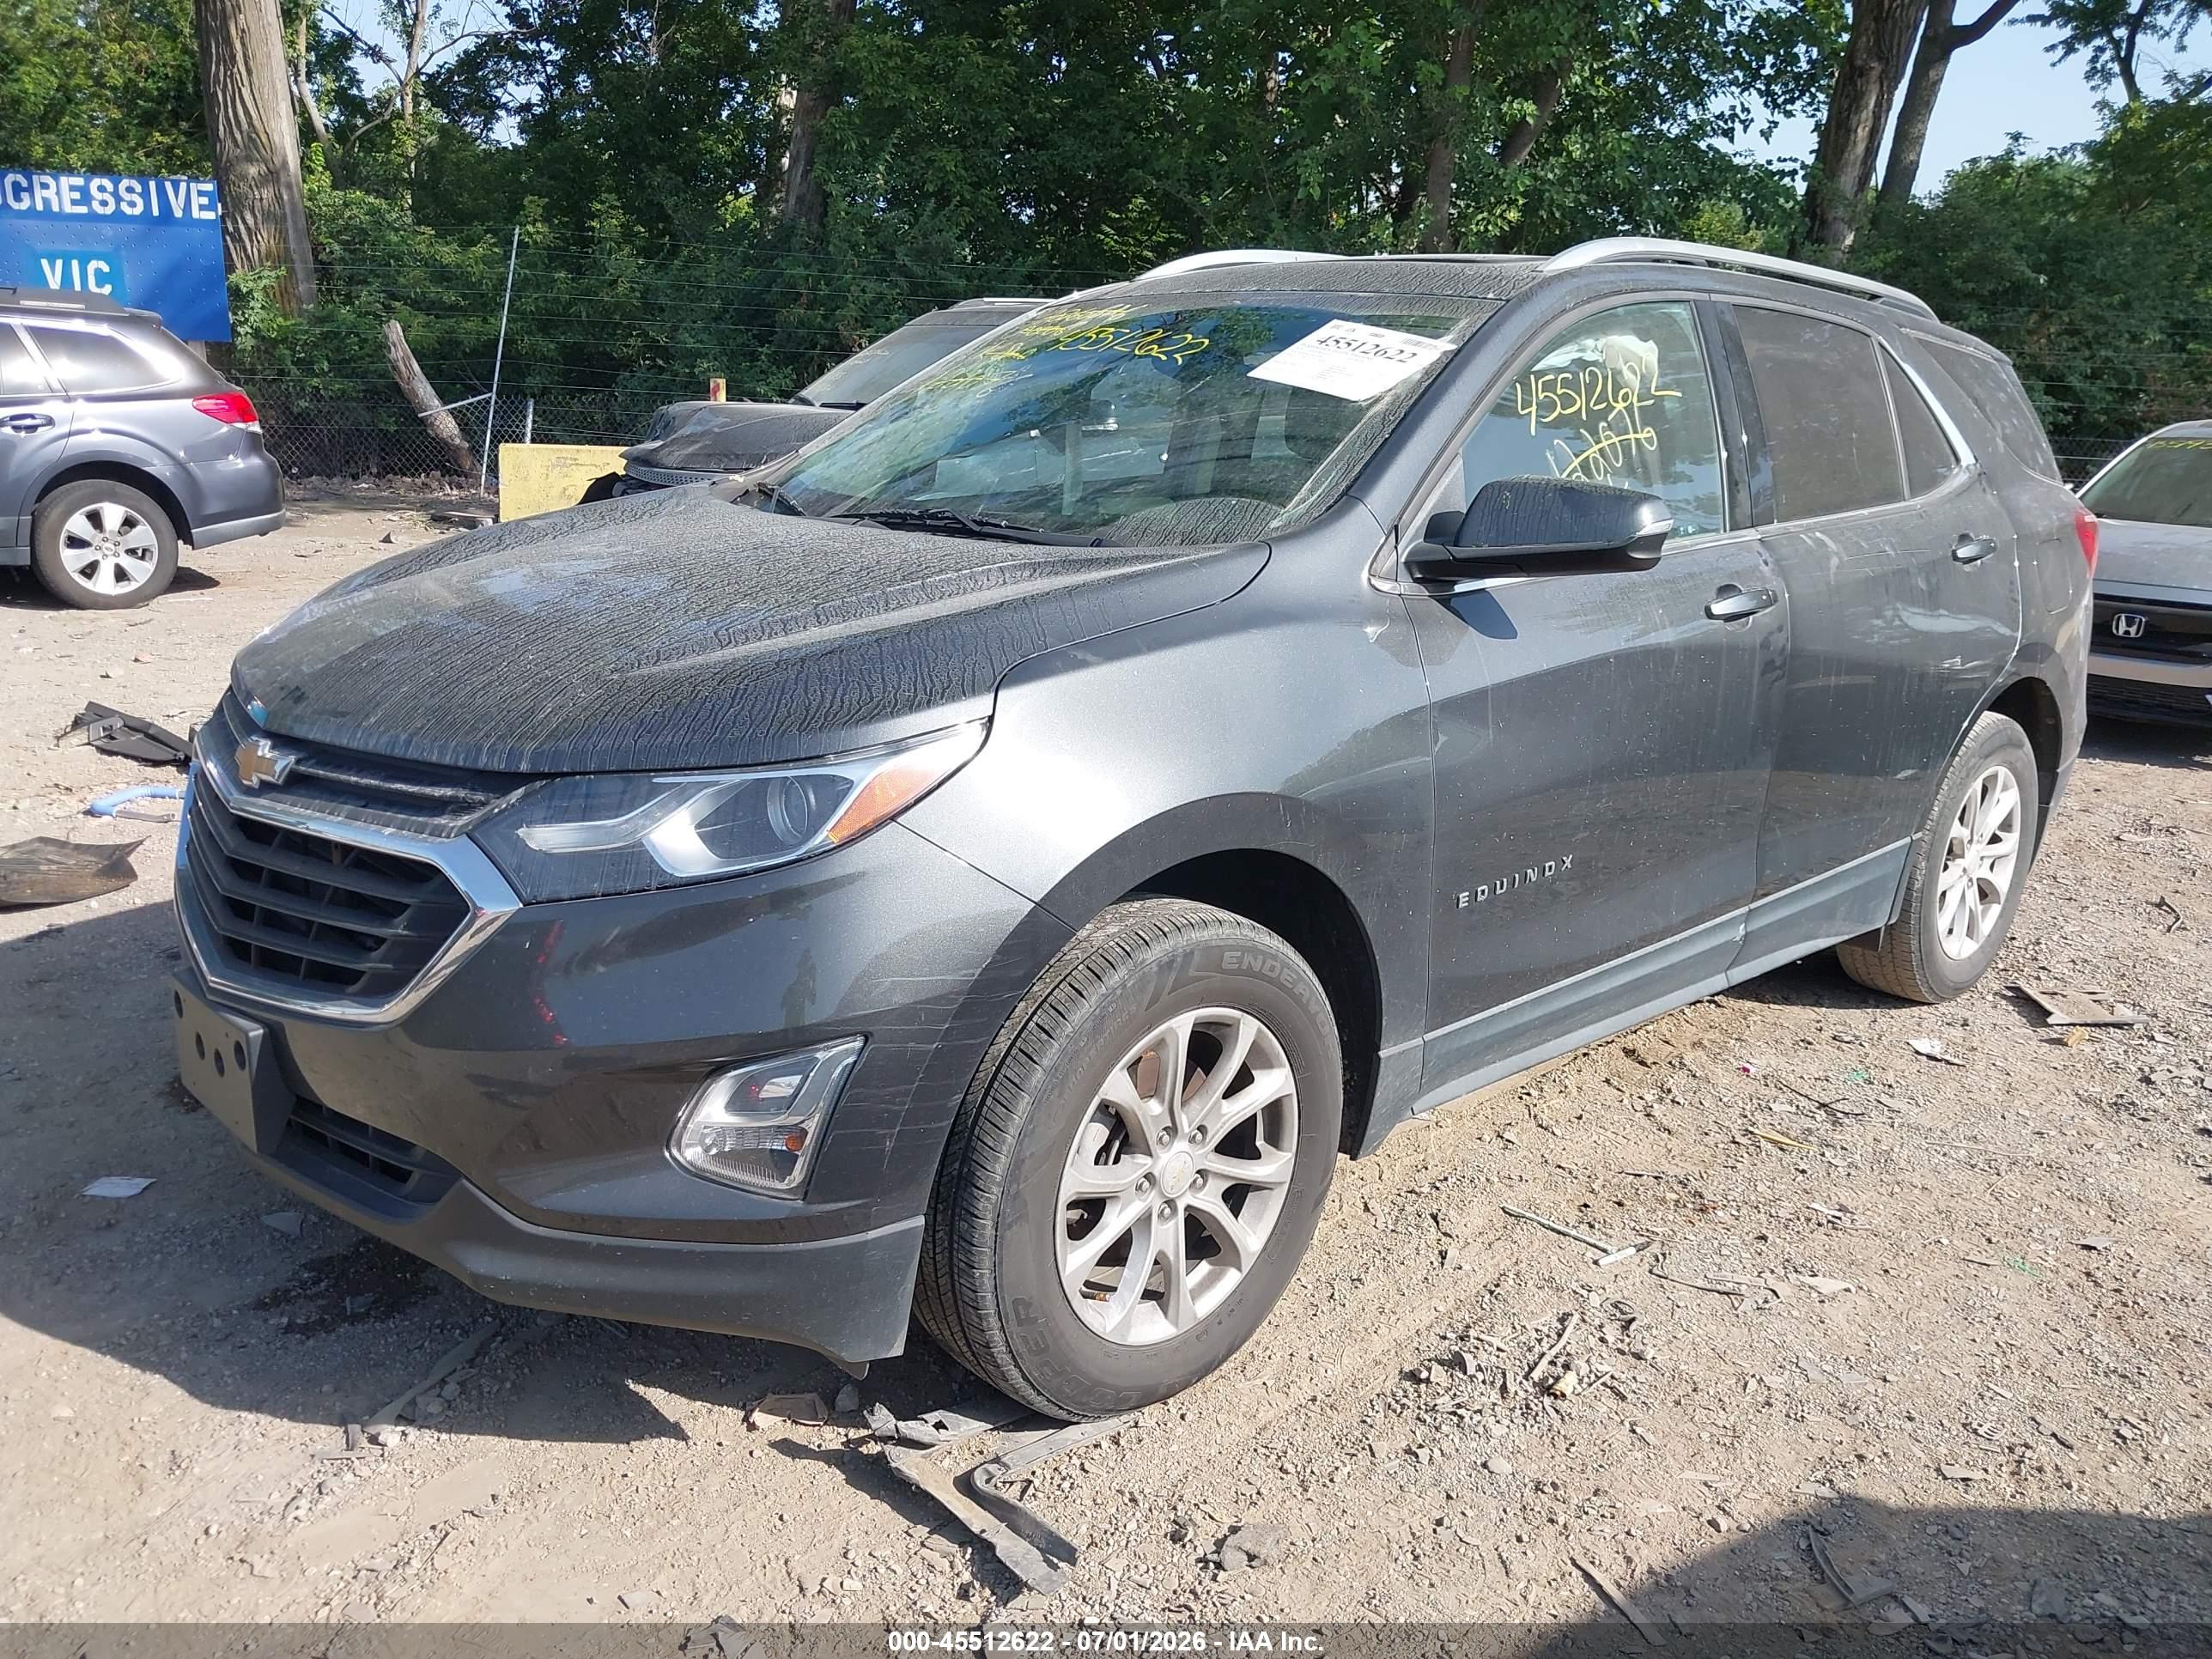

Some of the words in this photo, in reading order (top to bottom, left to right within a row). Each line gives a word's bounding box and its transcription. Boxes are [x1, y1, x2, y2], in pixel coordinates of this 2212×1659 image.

[0, 173, 216, 219] GRESSIVE
[40, 258, 112, 295] VIC
[1316, 336, 1418, 363] 45512622
[1456, 854, 1573, 908] EQUINOX
